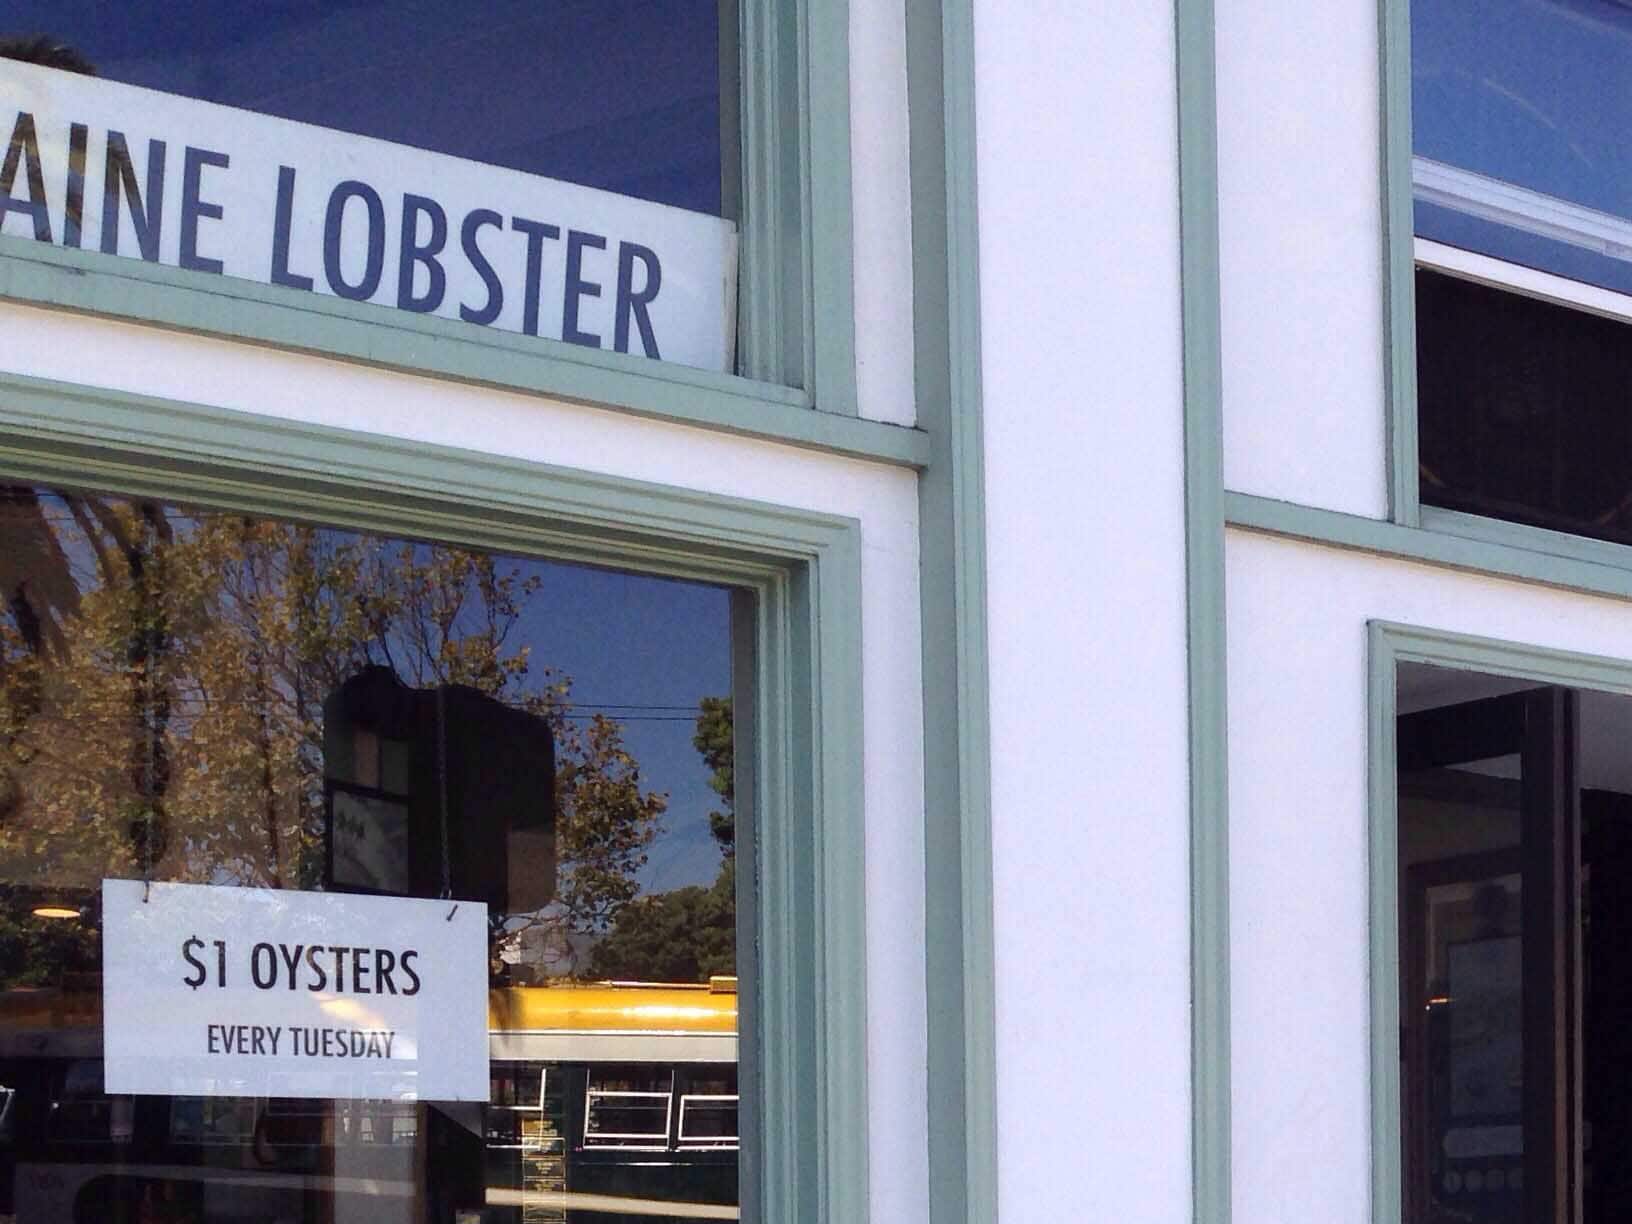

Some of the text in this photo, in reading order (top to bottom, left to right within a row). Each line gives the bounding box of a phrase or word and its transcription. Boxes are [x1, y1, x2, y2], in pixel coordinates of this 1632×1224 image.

[0, 111, 662, 360] AINE LOBSTER
[182, 935, 421, 996] $1 OYSTERS
[207, 1024, 396, 1060] EVERY TUESDAY
